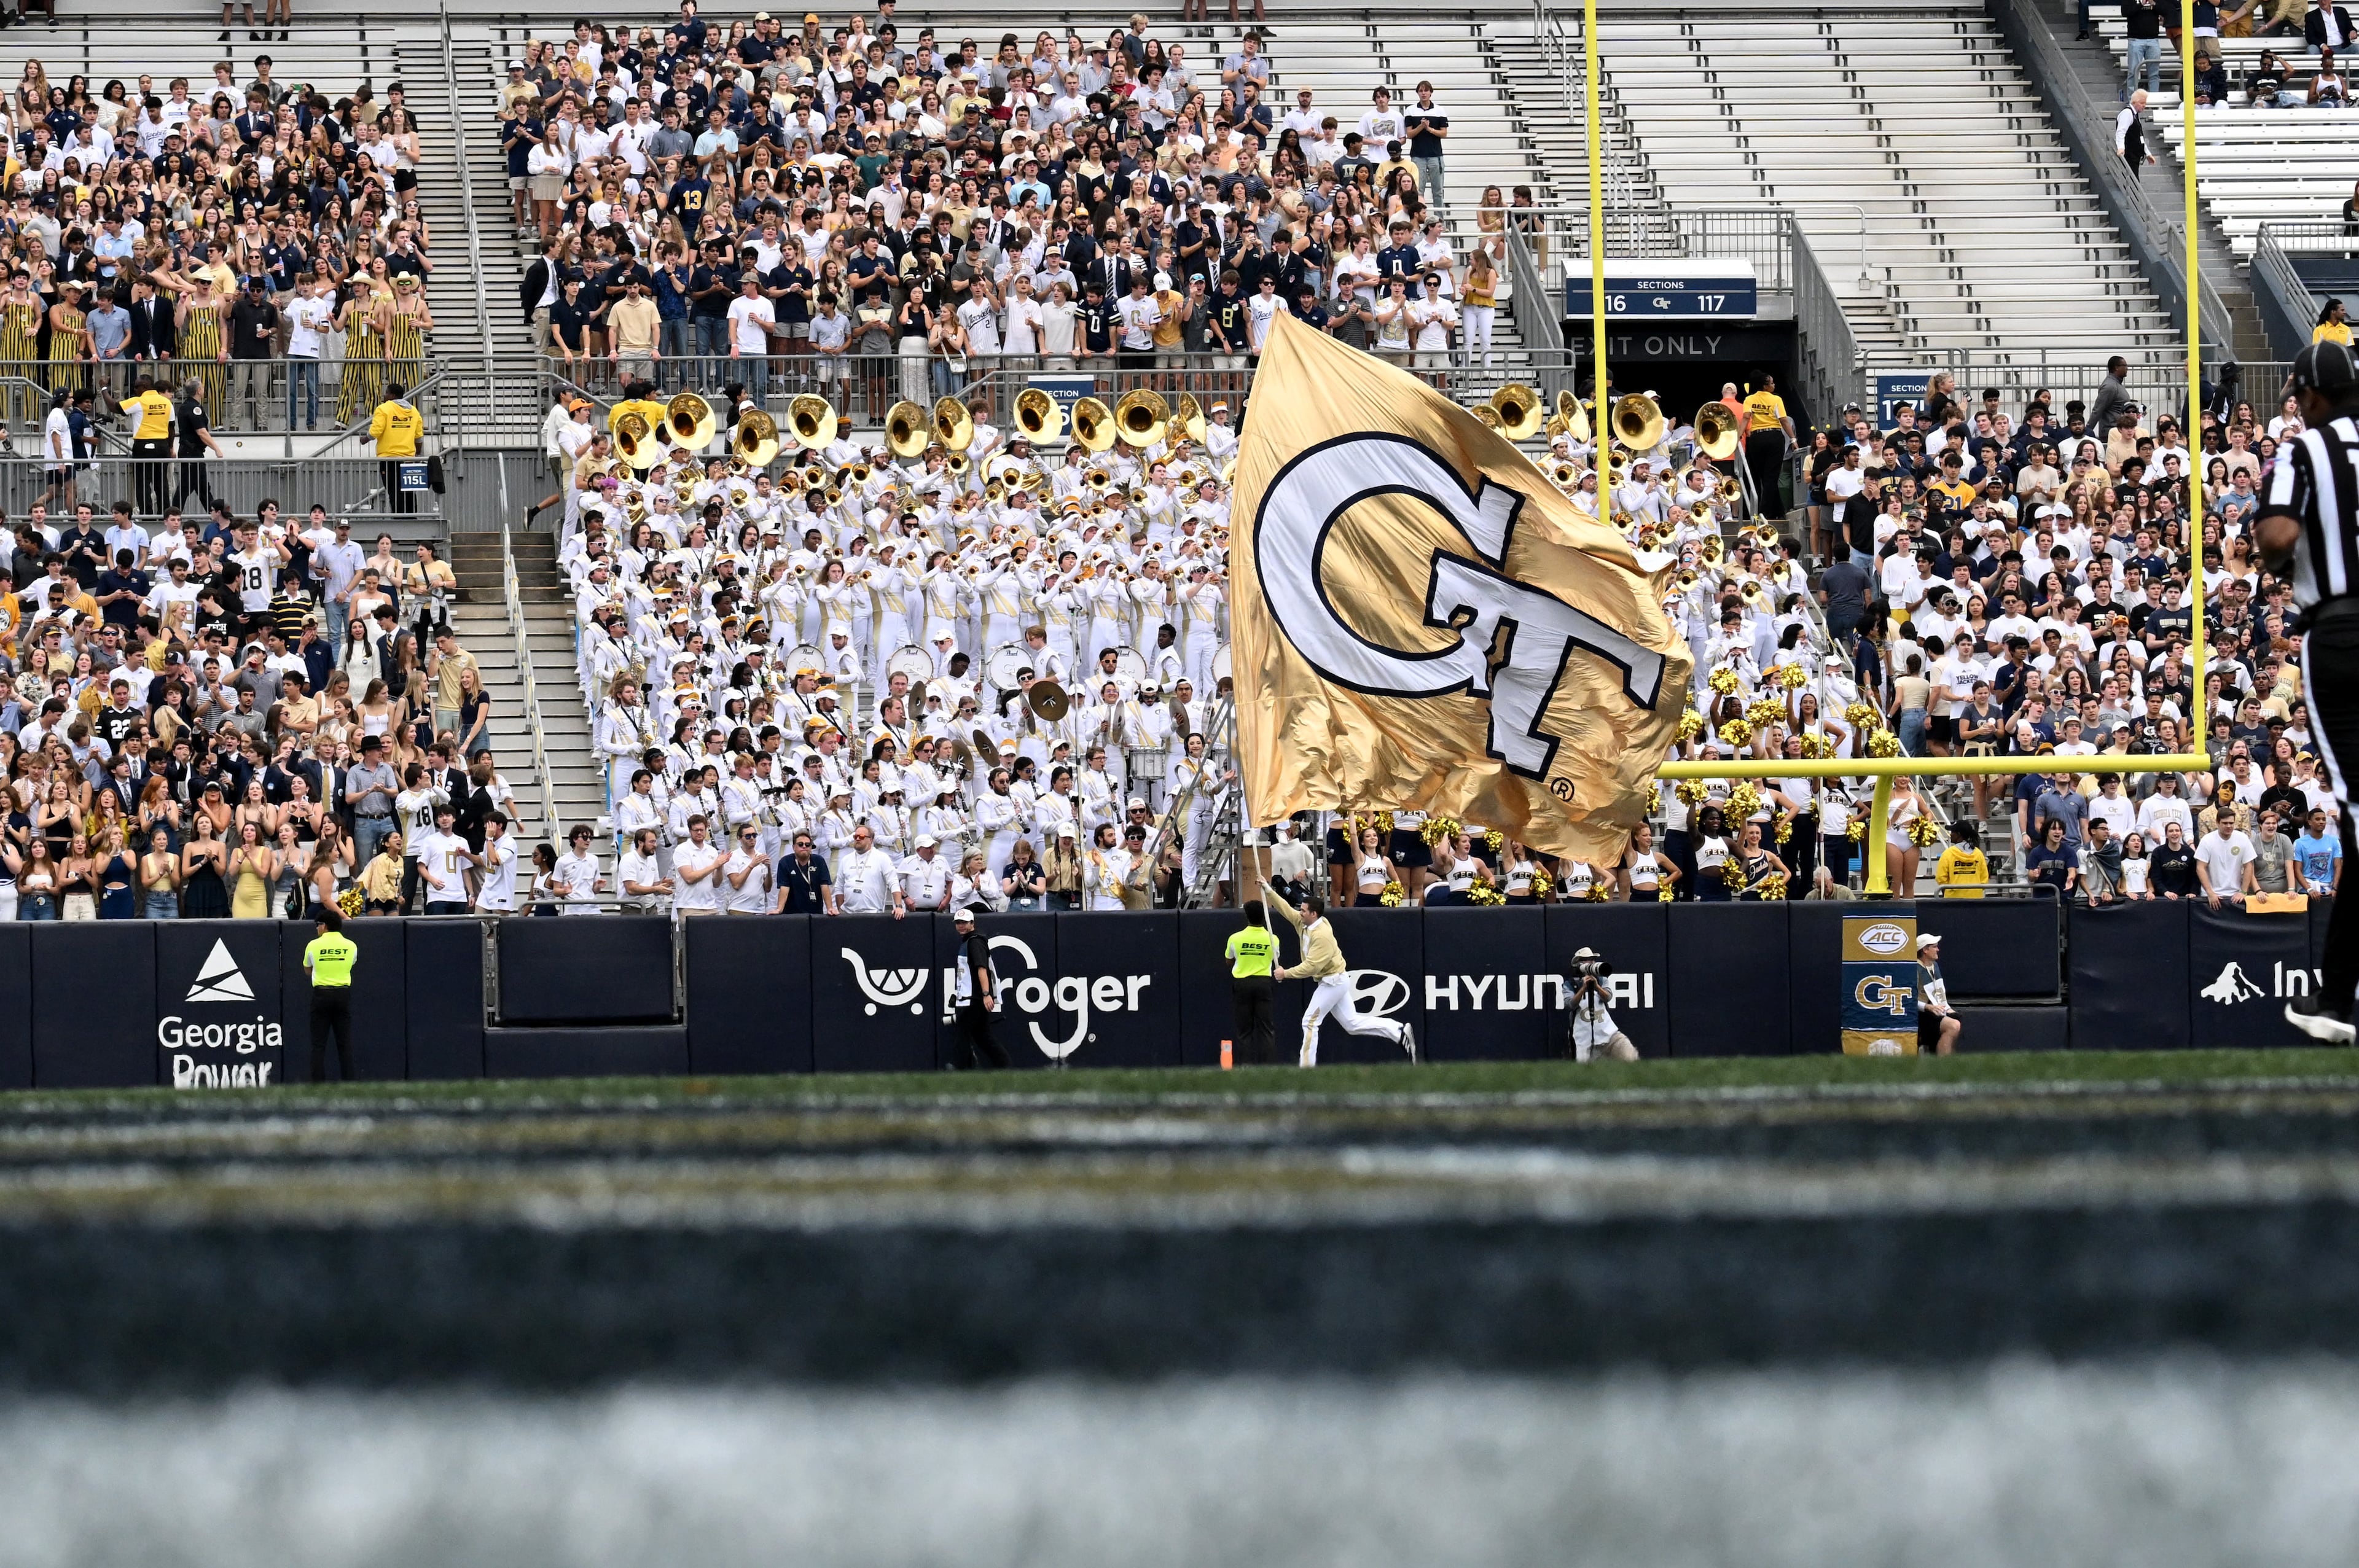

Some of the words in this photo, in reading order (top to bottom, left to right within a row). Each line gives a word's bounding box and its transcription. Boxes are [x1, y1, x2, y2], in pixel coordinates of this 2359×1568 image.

[145, 129, 166, 140] Jacket
[683, 190, 702, 209] 13
[1637, 281, 1684, 289] SECTIONS
[1604, 295, 1626, 311] 16
[1697, 295, 1725, 311] 117
[1223, 308, 1234, 328] 8
[1256, 311, 1273, 321] Jack
[1090, 315, 1100, 333] 0
[1645, 337, 1722, 356] ONLY
[1891, 384, 1927, 392] SECTION
[402, 475, 426, 485] 115L
[1944, 496, 1962, 510] 21
[241, 566, 262, 590] 18
[1253, 431, 1666, 783] GT
[206, 623, 227, 632] TECH
[111, 719, 131, 739] 22
[1705, 783, 1727, 794] TECH
[416, 806, 431, 828] 18
[1705, 848, 1727, 857] TECH
[446, 850, 457, 873] 0
[1362, 867, 1386, 876] TECH
[1453, 871, 1476, 880] TECH
[1636, 865, 1658, 875] TECH
[1570, 876, 1592, 885] TECH
[532, 887, 545, 898] ECH
[1868, 932, 1902, 942] ACC
[1425, 972, 1654, 1010] HYUNAI
[1855, 975, 1912, 1016] GT
[158, 1015, 283, 1055] Georgia
